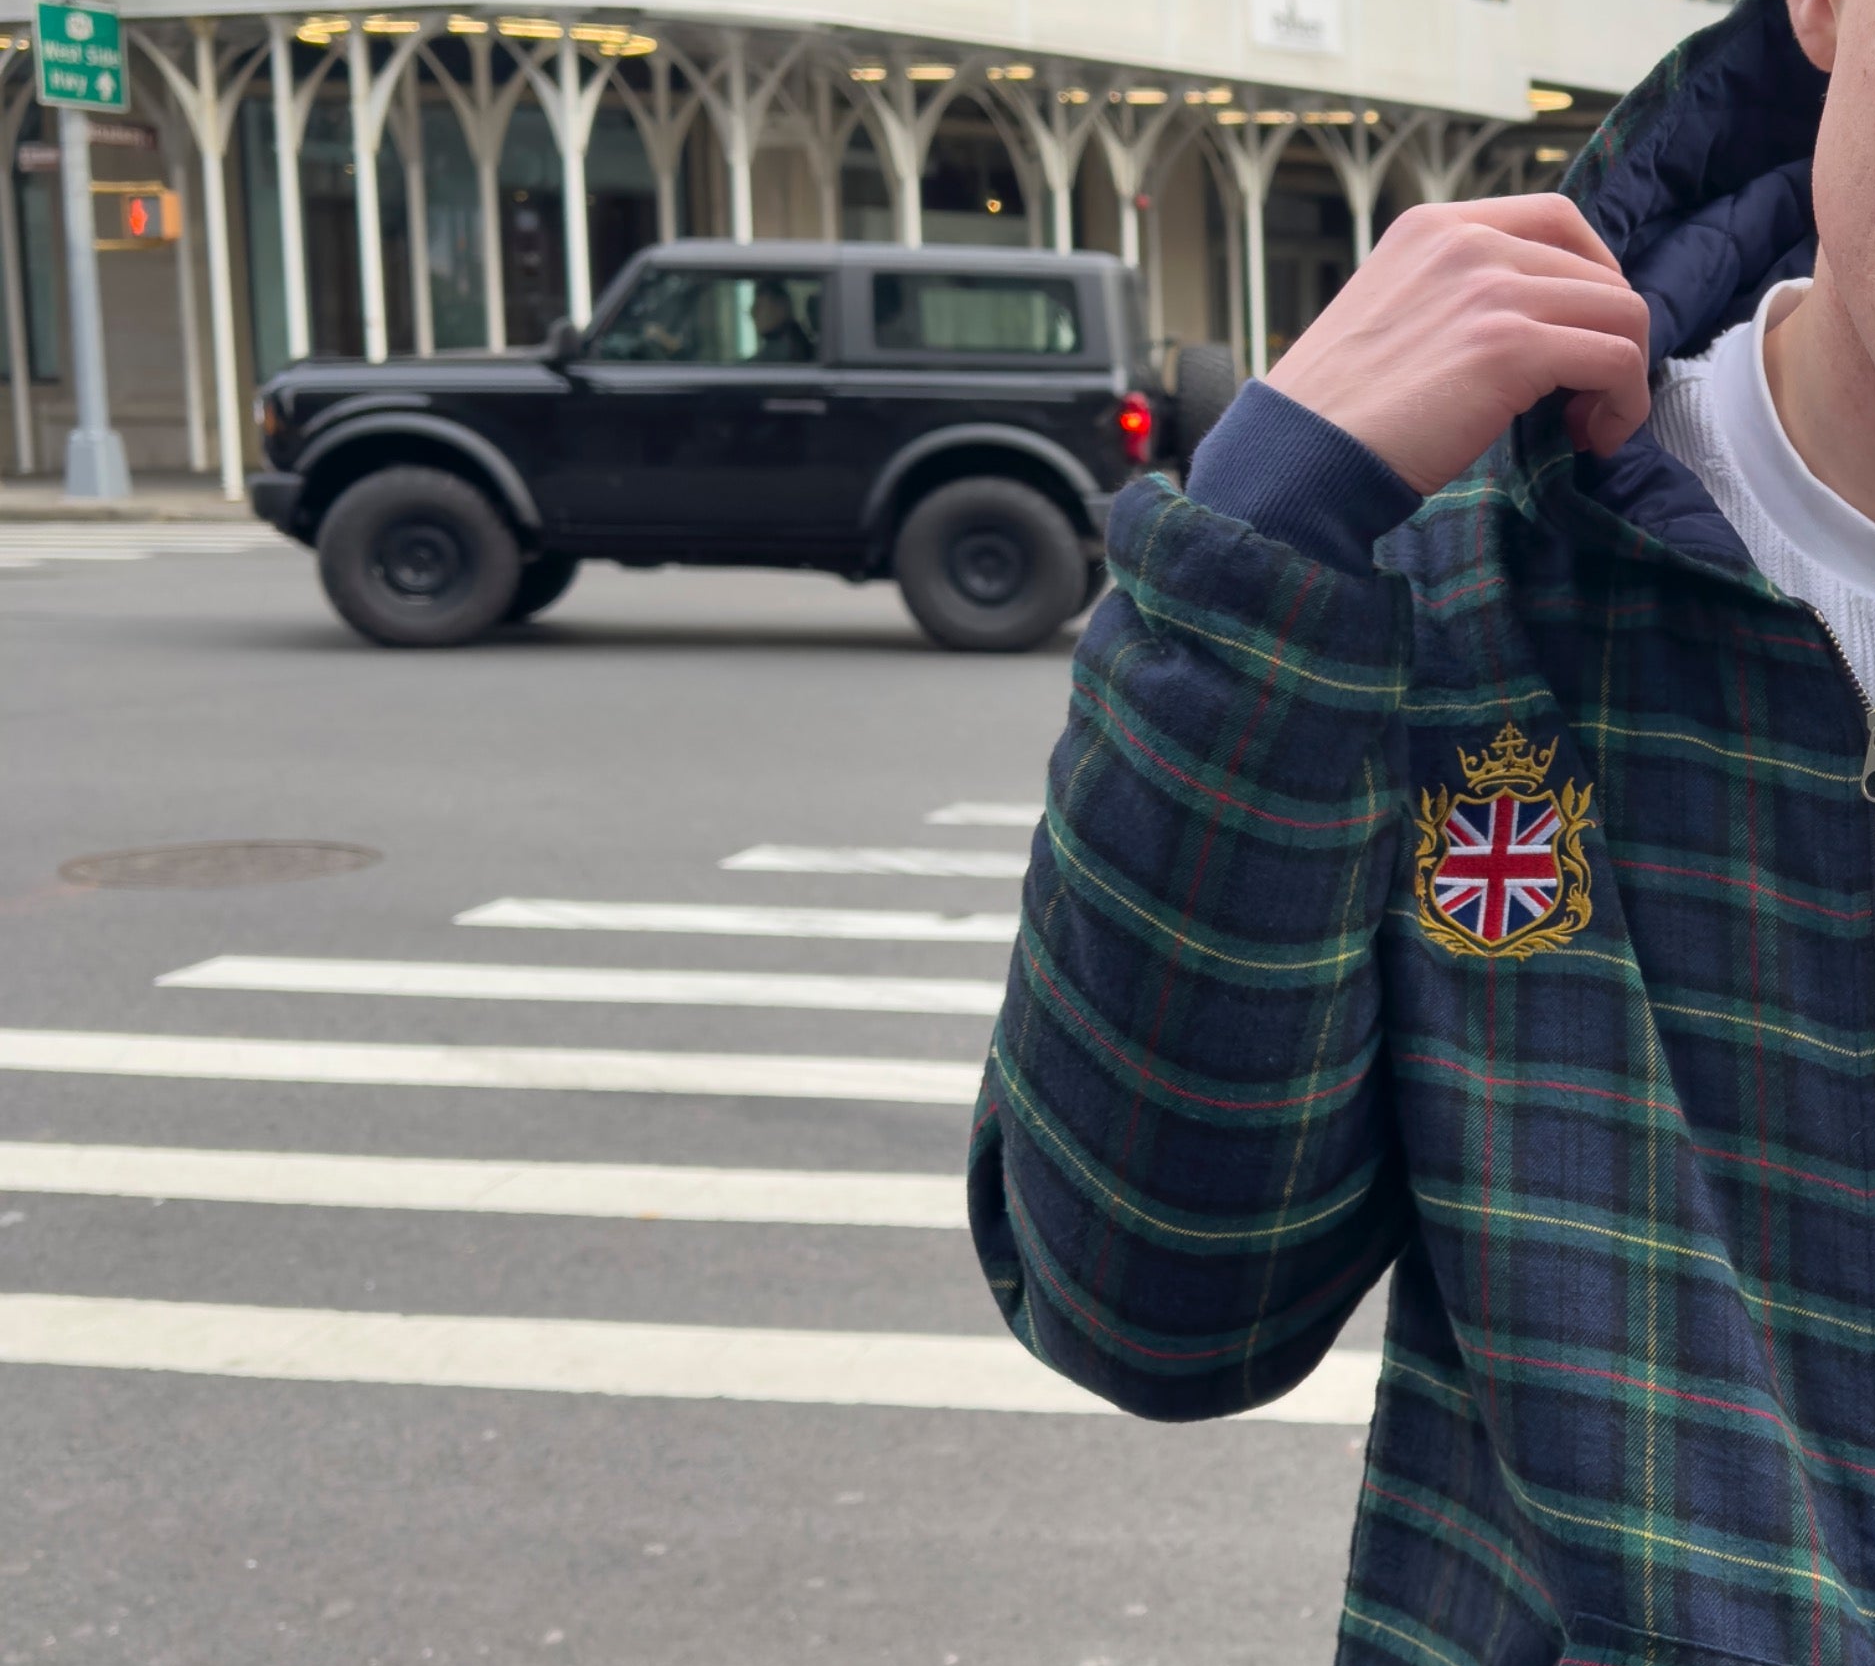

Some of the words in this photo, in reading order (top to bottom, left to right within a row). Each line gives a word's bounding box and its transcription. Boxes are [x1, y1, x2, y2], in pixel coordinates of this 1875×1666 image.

[43, 38, 82, 65] West
[85, 44, 121, 69] Side
[50, 69, 88, 98] Hwy
